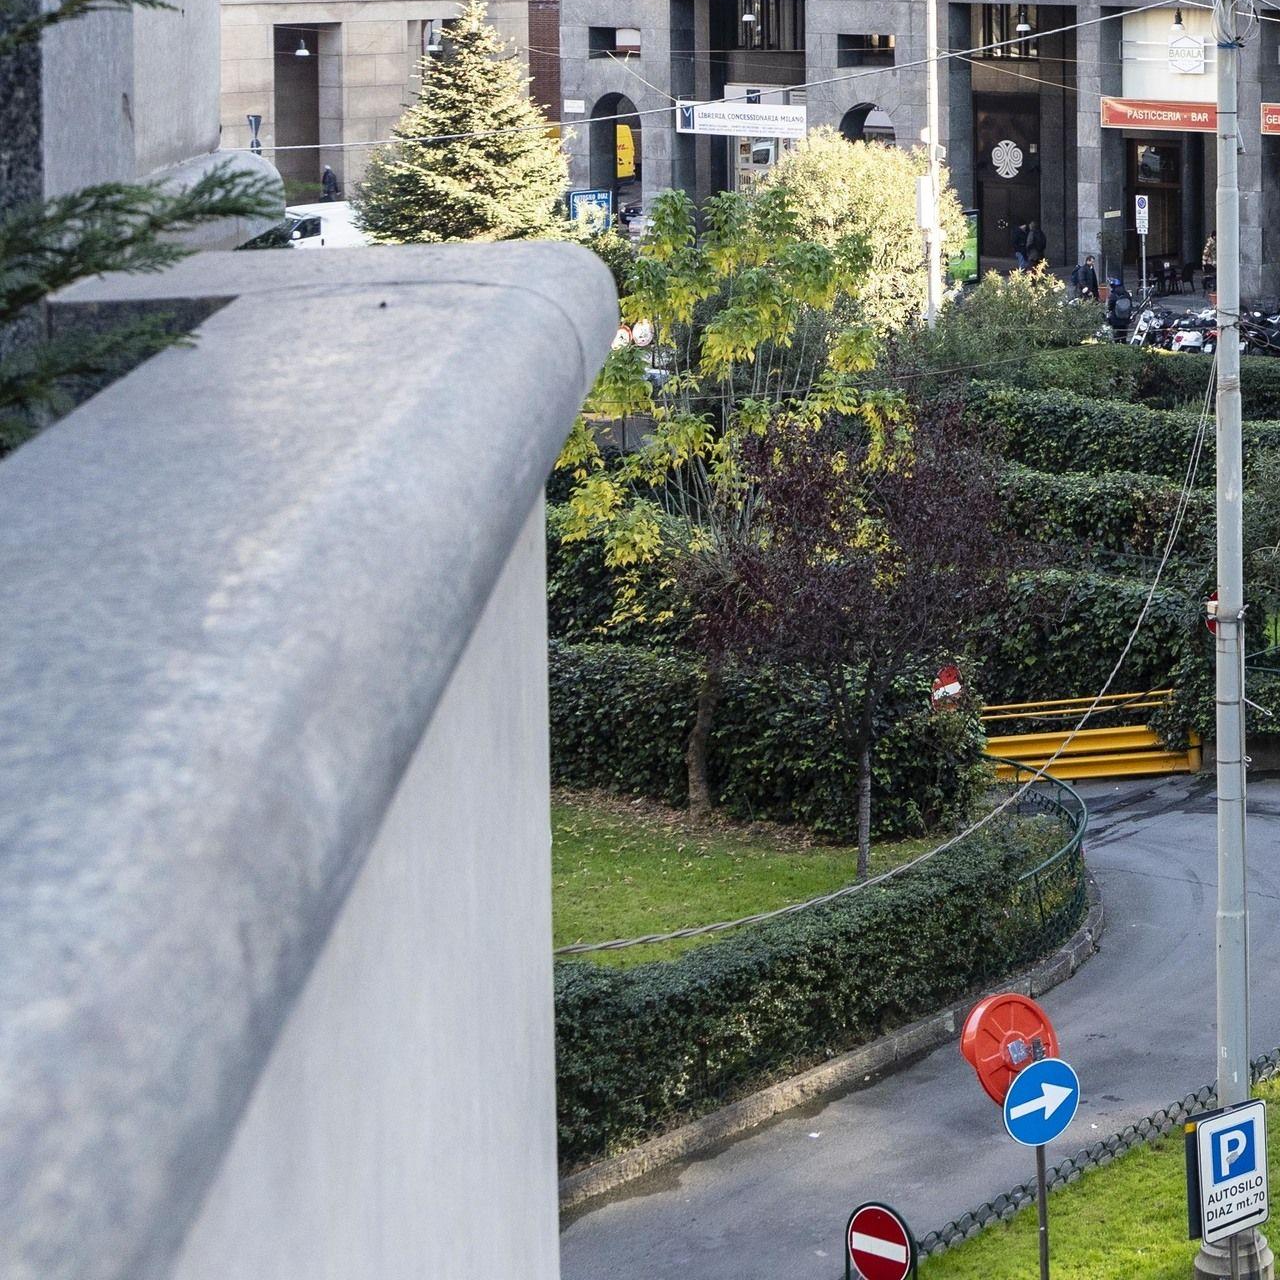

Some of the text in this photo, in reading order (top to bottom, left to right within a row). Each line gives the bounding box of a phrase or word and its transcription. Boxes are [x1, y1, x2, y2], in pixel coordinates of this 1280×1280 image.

[727, 113, 779, 121] CONCESSIONARIA
[1127, 109, 1209, 122] PASTICCERIA BAR
[1220, 1129, 1247, 1177] P
[1206, 1190, 1265, 1222] DIAZ mt.70
[1207, 1175, 1263, 1206] AUTOSILO
